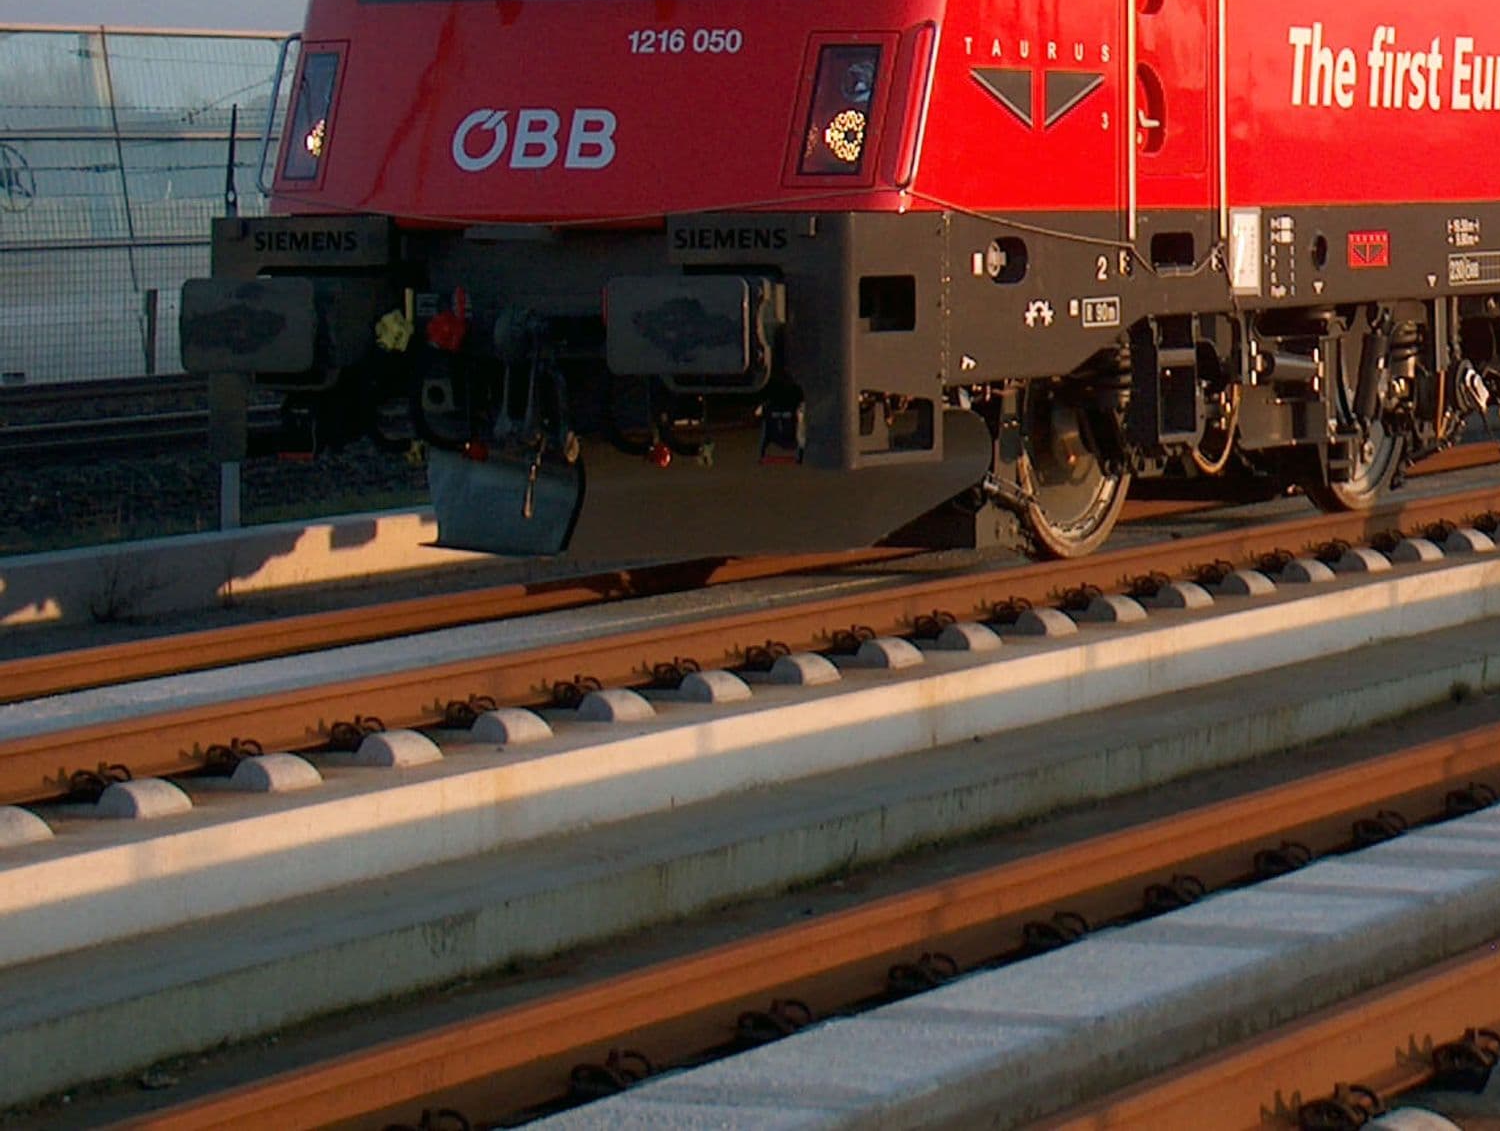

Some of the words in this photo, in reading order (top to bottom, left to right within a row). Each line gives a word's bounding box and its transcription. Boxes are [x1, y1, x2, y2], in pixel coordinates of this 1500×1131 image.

[627, 30, 686, 53] 1216
[692, 29, 742, 53] 050
[1289, 22, 1357, 109] The
[1367, 25, 1444, 111] first
[1101, 112, 1110, 130] 3
[452, 108, 617, 171] ÖBB
[254, 230, 359, 252] SIEMENS
[673, 227, 788, 250] SIEMENS
[1097, 255, 1108, 280] 2
